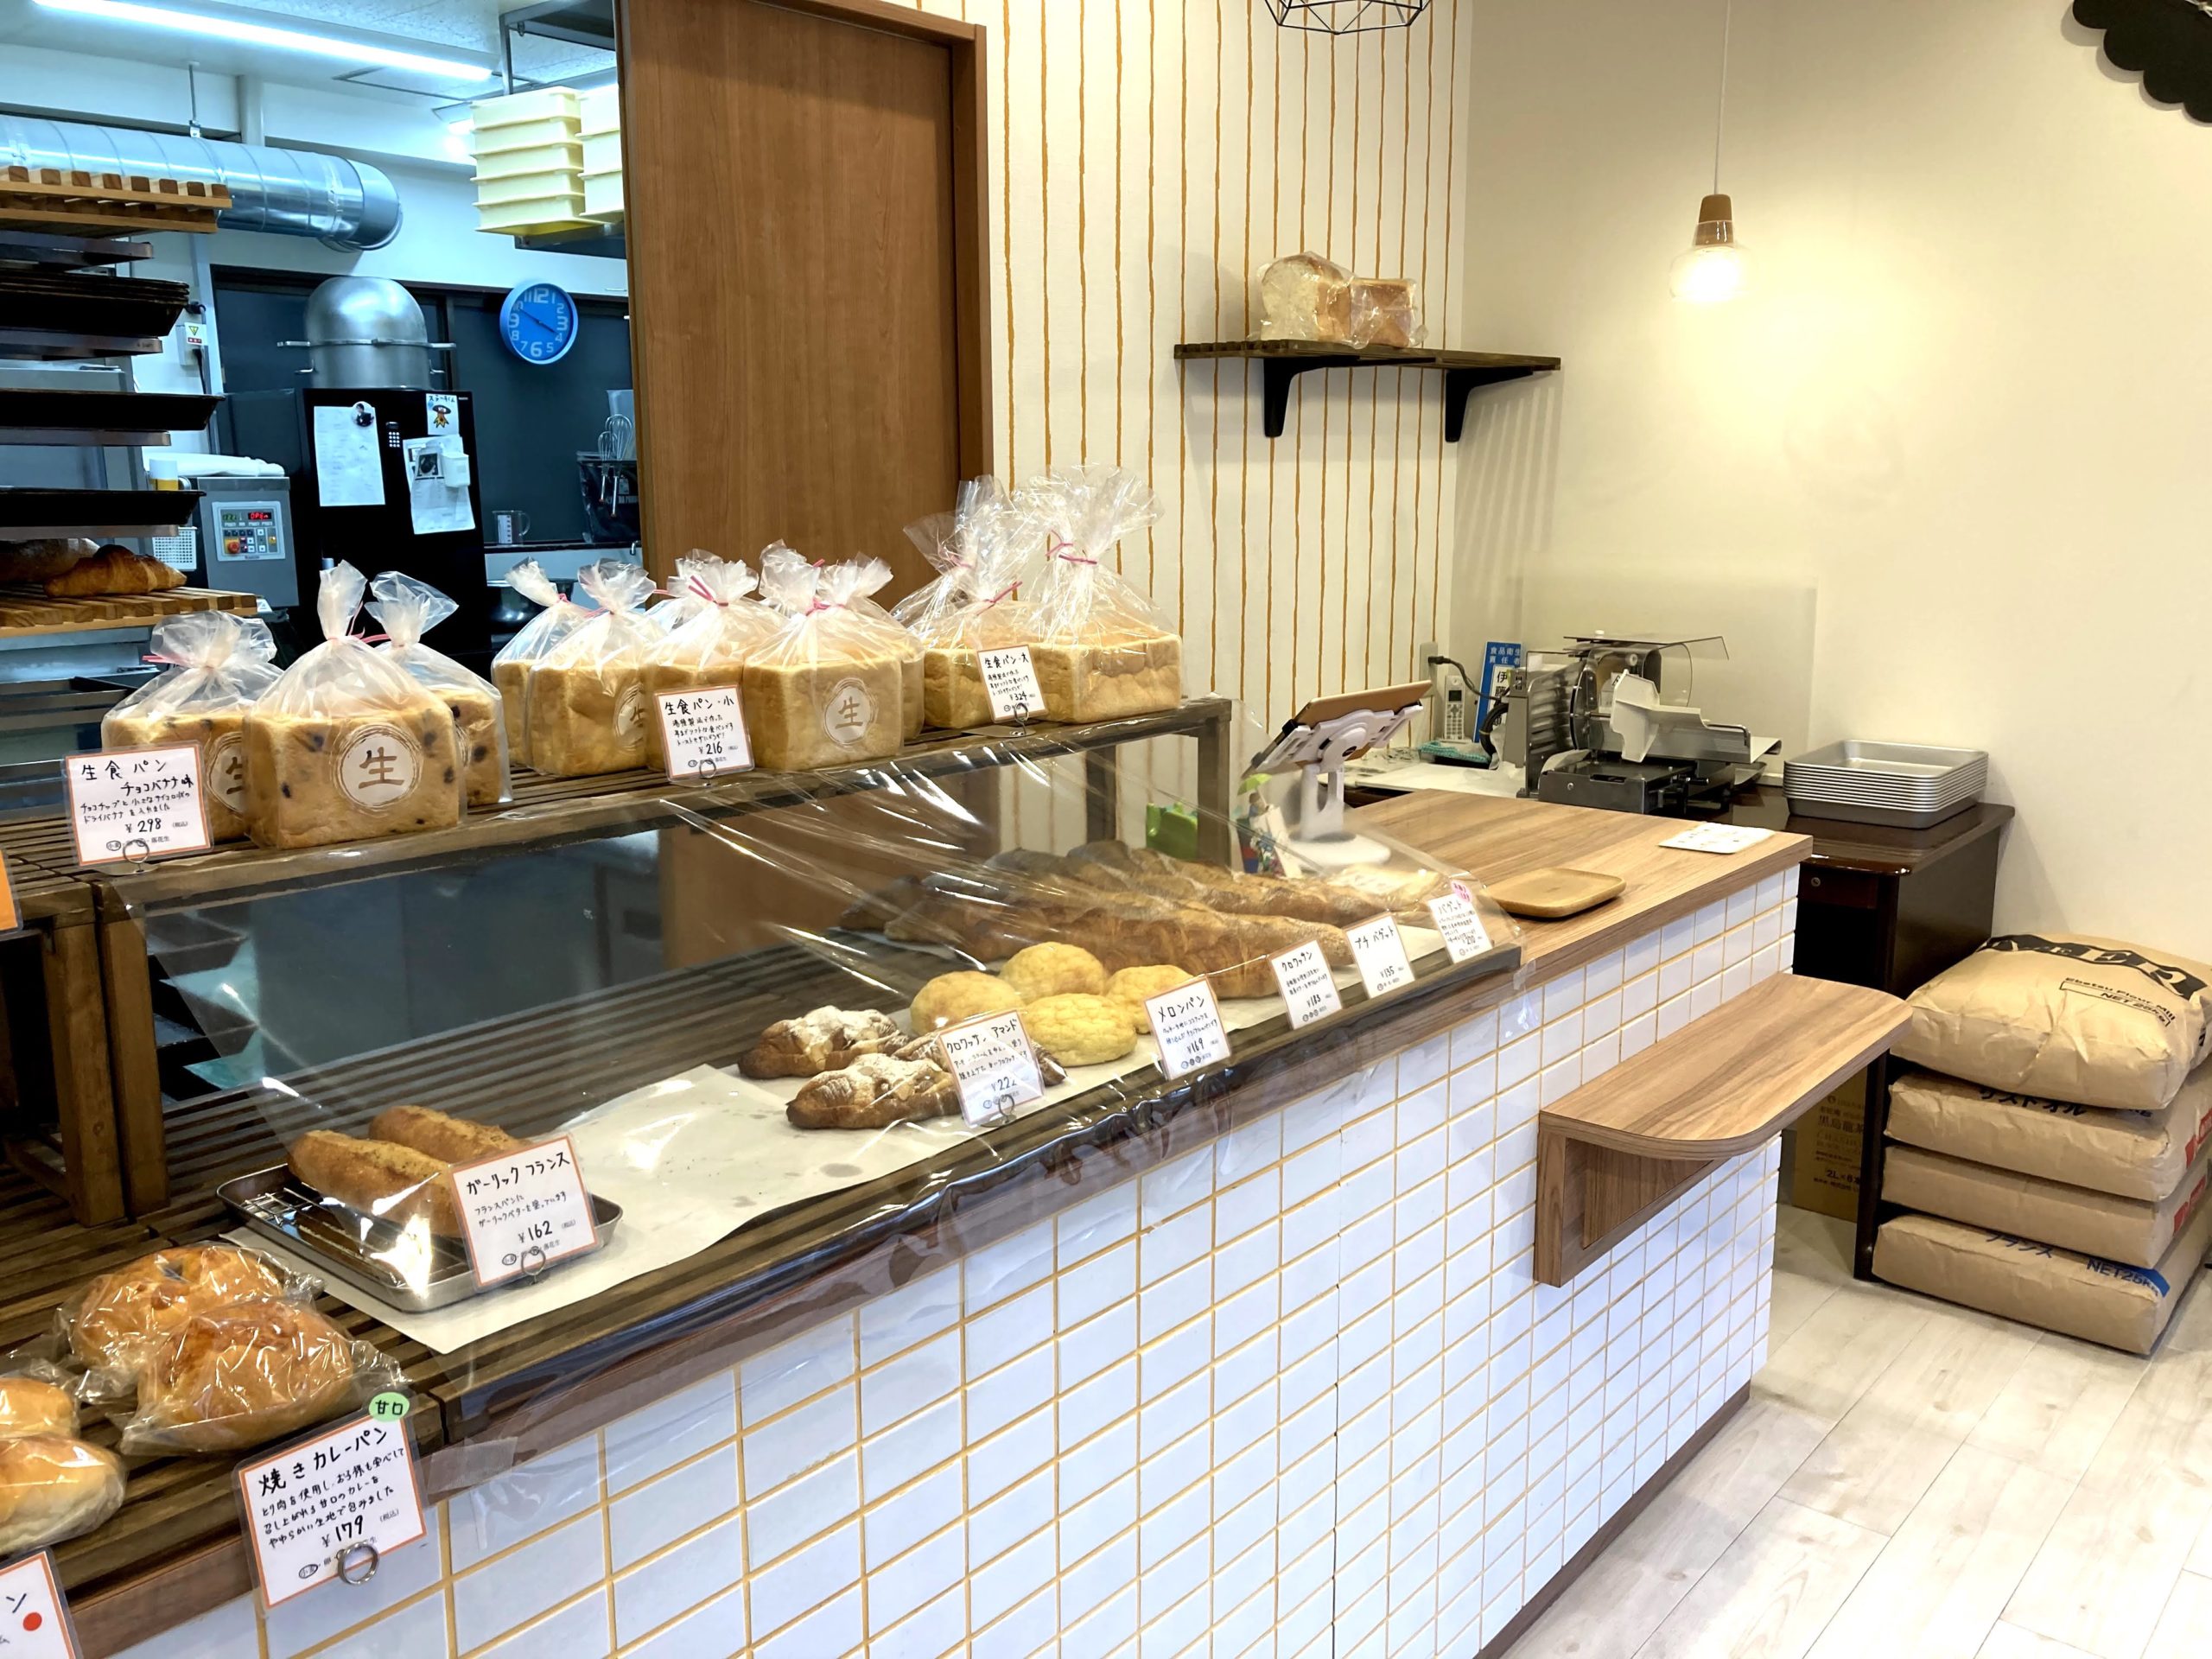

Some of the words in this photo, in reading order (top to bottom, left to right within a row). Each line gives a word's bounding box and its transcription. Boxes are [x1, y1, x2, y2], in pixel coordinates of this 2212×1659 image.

[533, 287, 549, 304] 12
[556, 303, 564, 314] 2
[509, 313, 519, 328] 9
[556, 316, 568, 331] 3
[512, 330, 519, 340] 8
[555, 333, 563, 342] 4
[520, 340, 528, 352] 7
[531, 341, 543, 357] 6
[546, 342, 554, 353] 5
[1491, 646, 1521, 656] 食品衛生
[835, 696, 863, 729] 生
[699, 741, 722, 754] ¥216
[82, 760, 166, 780] 生食パン
[359, 747, 404, 789] 生
[121, 774, 194, 796] チョコバナナ味
[125, 817, 162, 833] ¥298
[2101, 993, 2133, 1004] NET
[2116, 989, 2153, 1004] Flour
[2156, 1004, 2176, 1021] Mill
[1159, 995, 1205, 1023] メロンパン
[518, 1220, 553, 1243] ¥162
[376, 1400, 404, 1415] 甘口
[258, 1427, 387, 1497] 焼きカレーパン
[321, 1515, 364, 1548] ¥179
